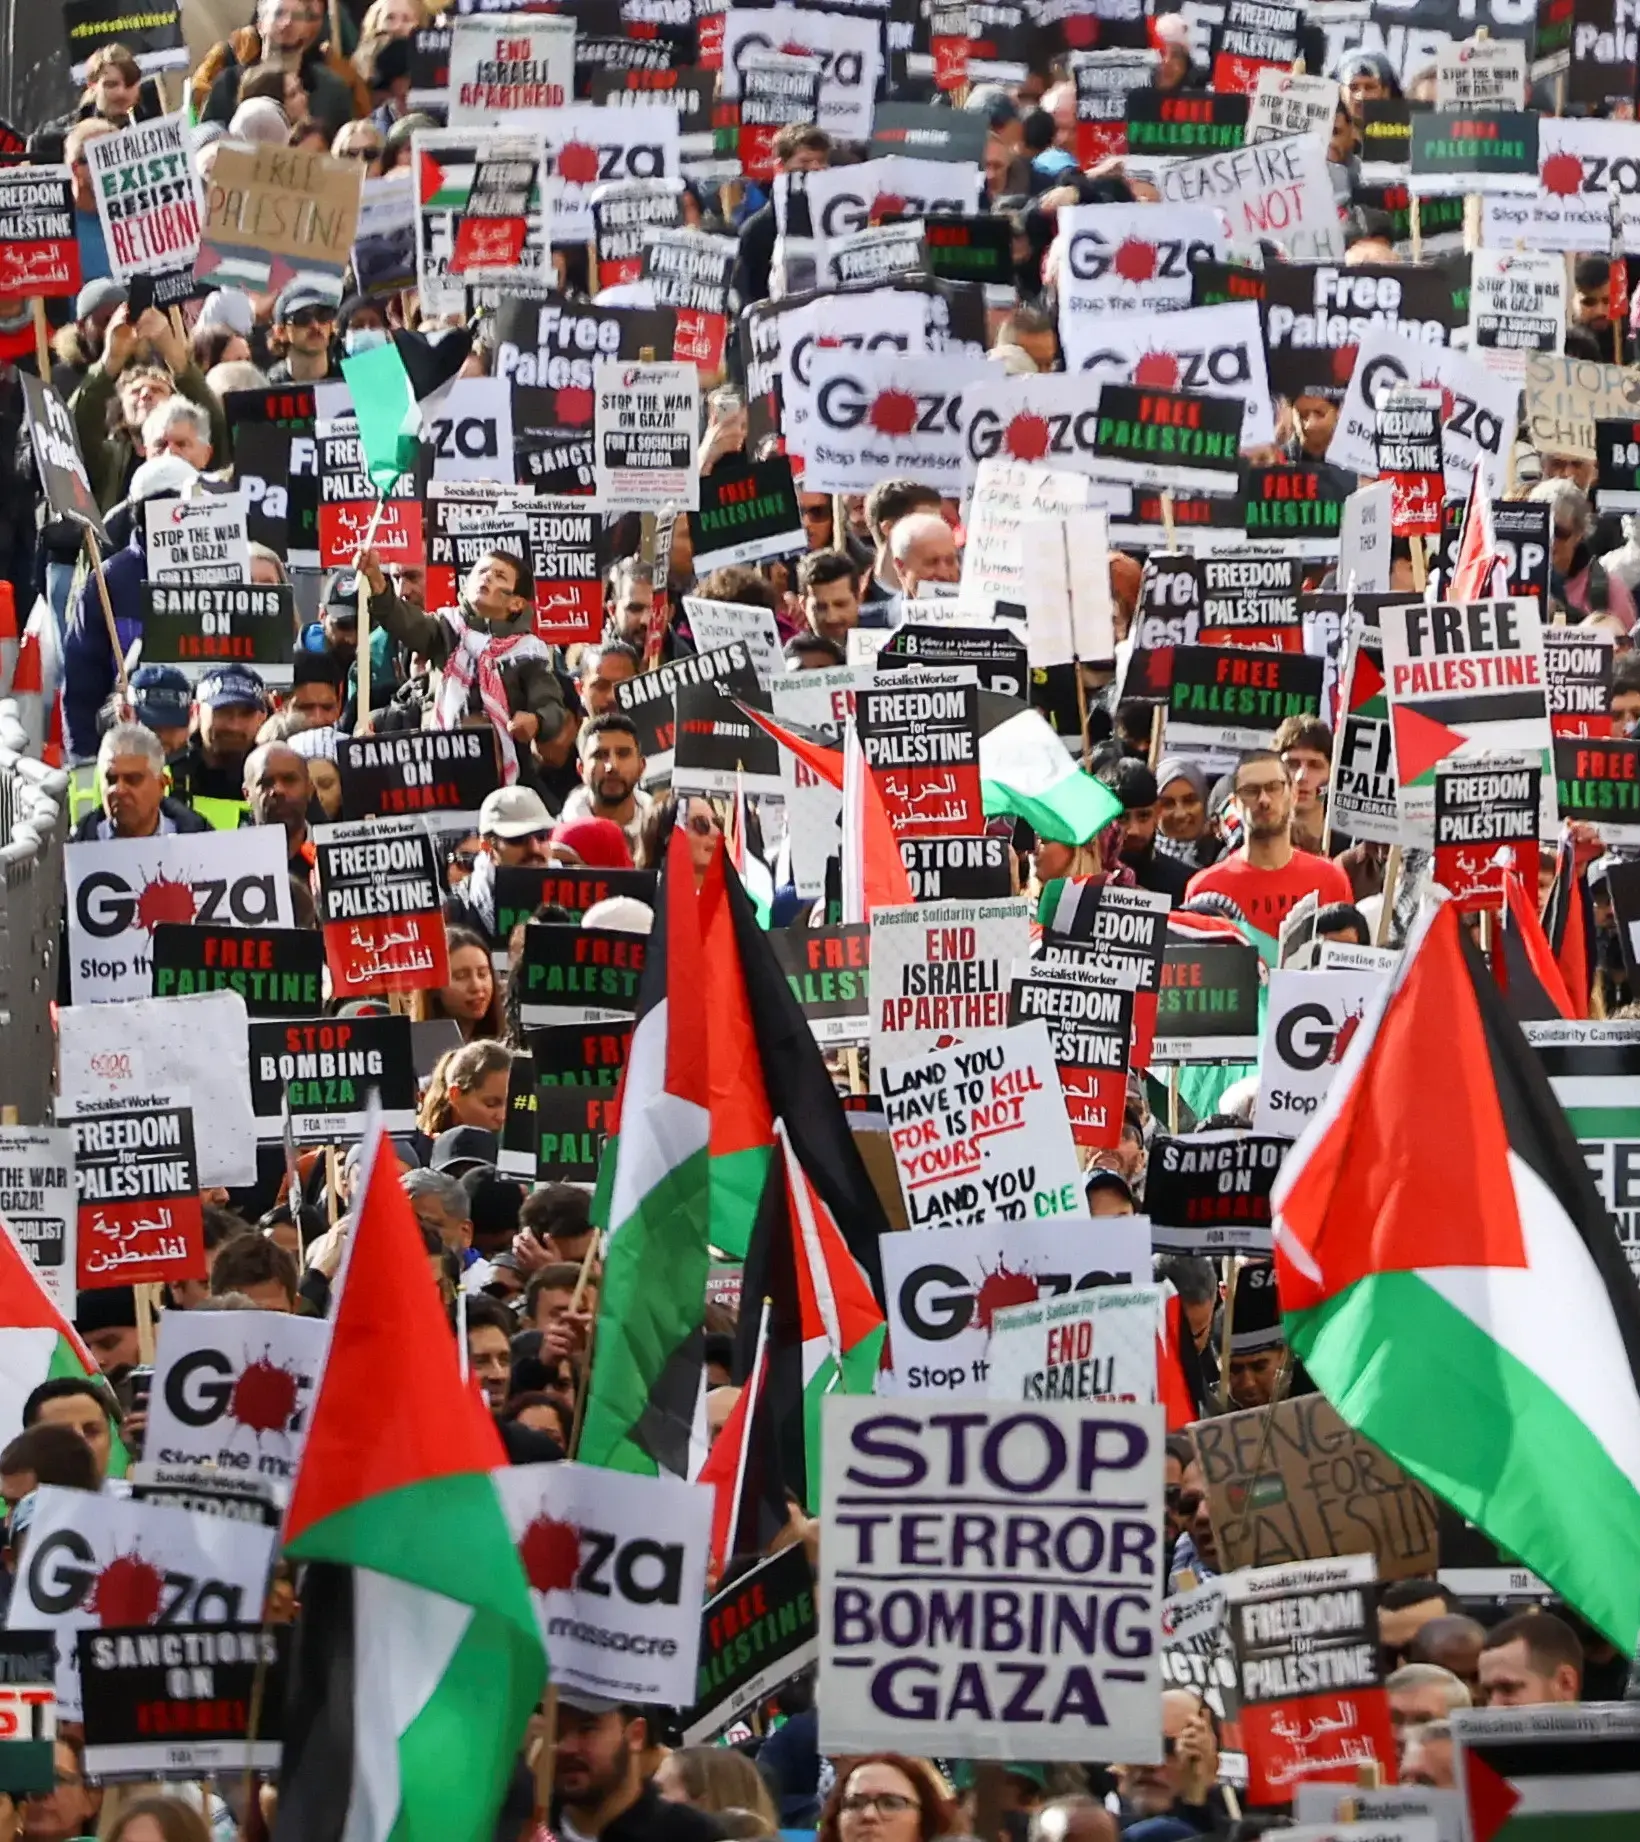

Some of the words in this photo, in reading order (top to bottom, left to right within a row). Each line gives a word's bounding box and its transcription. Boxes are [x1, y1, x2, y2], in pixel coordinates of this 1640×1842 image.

[495, 39, 531, 61] END
[476, 59, 549, 85] ISRAELI
[459, 83, 565, 109] APARTHEID
[95, 137, 121, 170] FREE
[123, 122, 182, 160] PALESTINE
[102, 152, 189, 198] EXIST!
[1164, 141, 1305, 201] CEASEFIRE
[107, 178, 194, 221] RESIST!
[1244, 183, 1305, 234] NOT
[112, 200, 200, 265] RETURN!
[205, 187, 348, 249] PALESTINE
[1314, 269, 1401, 310] Free
[1269, 308, 1445, 348] Palestine
[1139, 396, 1200, 424] FREE
[1100, 415, 1237, 460] PALESTINE
[718, 476, 757, 500] FREE
[700, 497, 784, 531] PALESTINE
[153, 531, 183, 548] STOP
[188, 529, 210, 545] THE
[214, 525, 241, 542] WAR
[170, 545, 193, 561] ON
[196, 542, 228, 560] GAZA!
[1205, 562, 1292, 590] FREEDOM
[153, 590, 280, 614] SANCTIONS
[1203, 600, 1299, 626] PALESTINE
[201, 612, 230, 636] ON
[1405, 602, 1522, 658] FREE
[178, 636, 255, 658] ISRAEL
[872, 674, 922, 687] Socialist
[923, 672, 960, 686] Worker
[1392, 652, 1541, 695] PALESTINE
[867, 691, 966, 721] FREEDOM
[864, 730, 974, 764] PALESTINE
[884, 773, 957, 802] الحرية
[1444, 771, 1530, 803] FREEDOM
[332, 826, 375, 839] Socialist
[378, 823, 416, 837] Worker
[1439, 807, 1535, 840] PALESTINE
[328, 841, 424, 873] FREEDOM
[75, 870, 280, 939] Gza
[327, 887, 434, 918] PALESTINE
[872, 909, 920, 927] Palestine
[922, 906, 976, 926] Solidarity
[978, 904, 1029, 923] Campaign
[350, 921, 419, 946] الحرية
[925, 928, 976, 960] END
[79, 957, 128, 981] Stop
[203, 937, 273, 969] FREE
[345, 947, 434, 984] لفلسطين
[157, 967, 318, 1002] PALESTINE
[902, 959, 999, 996] ISRAELI
[285, 1026, 352, 1052] STOP
[260, 1051, 384, 1082] BOMBING
[880, 1063, 947, 1098] LAND
[954, 1045, 1004, 1078] YOU
[288, 1078, 356, 1106] GAZA
[886, 1088, 950, 1125] HAVE
[954, 1080, 984, 1105] TO
[991, 1065, 1043, 1098] KILL
[71, 1116, 181, 1151] FREEDOM
[302, 1118, 322, 1131] FOA
[892, 1120, 940, 1152] FOR
[946, 1110, 967, 1136] IS
[971, 1097, 1025, 1132] NOT
[73, 1161, 191, 1197] PALESTINE
[1033, 1184, 1078, 1218] DIE
[845, 1412, 1150, 1493] STOP
[835, 1512, 1158, 1577] TERROR
[548, 1615, 678, 1659] massacre
[832, 1588, 1155, 1658] BOMBING
[92, 1632, 277, 1669] SANCTIONS
[165, 1668, 215, 1699] ON
[869, 1658, 1110, 1729] GAZA
